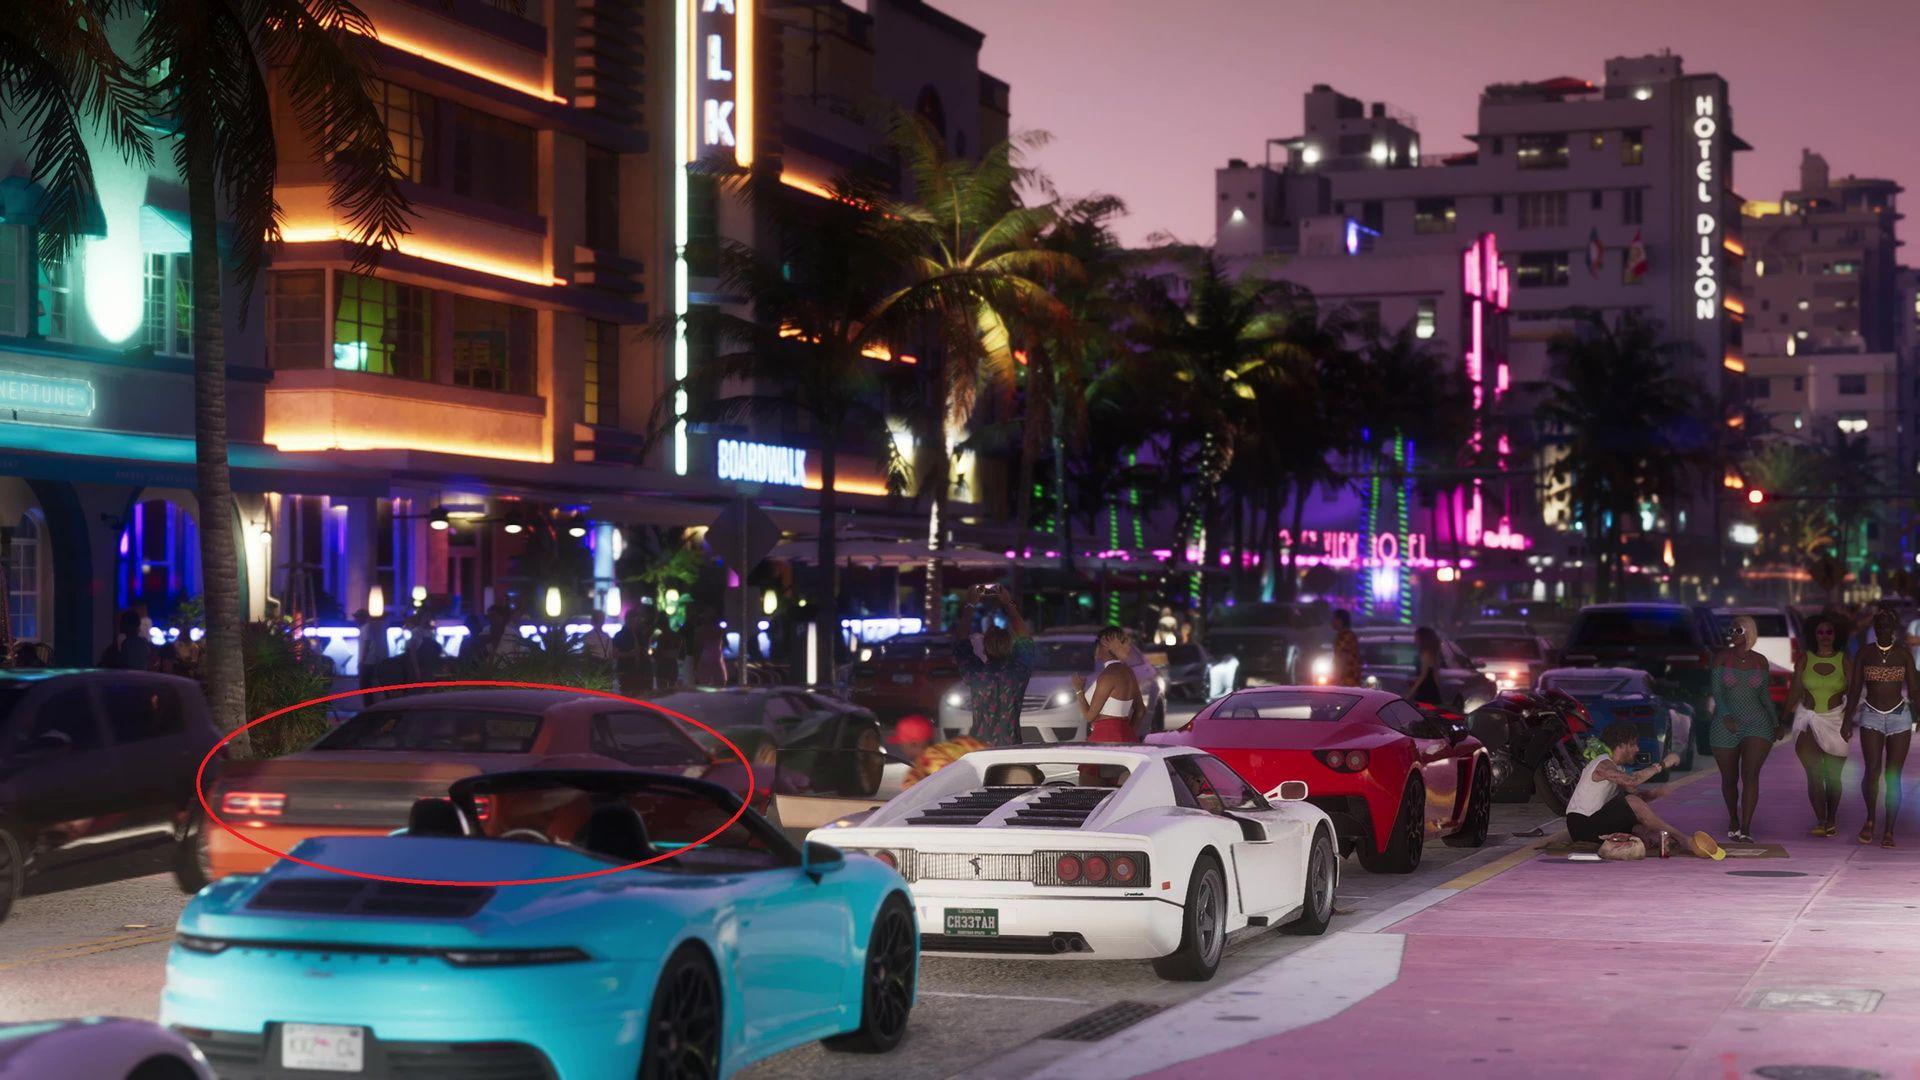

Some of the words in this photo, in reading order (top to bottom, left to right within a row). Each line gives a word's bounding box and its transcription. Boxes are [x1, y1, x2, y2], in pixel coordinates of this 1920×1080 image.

[1693, 95, 1716, 203] HOTEL
[1694, 213, 1717, 320] DIXON
[718, 439, 806, 486] BOARDWALK
[947, 915, 995, 929] CH33TAH
